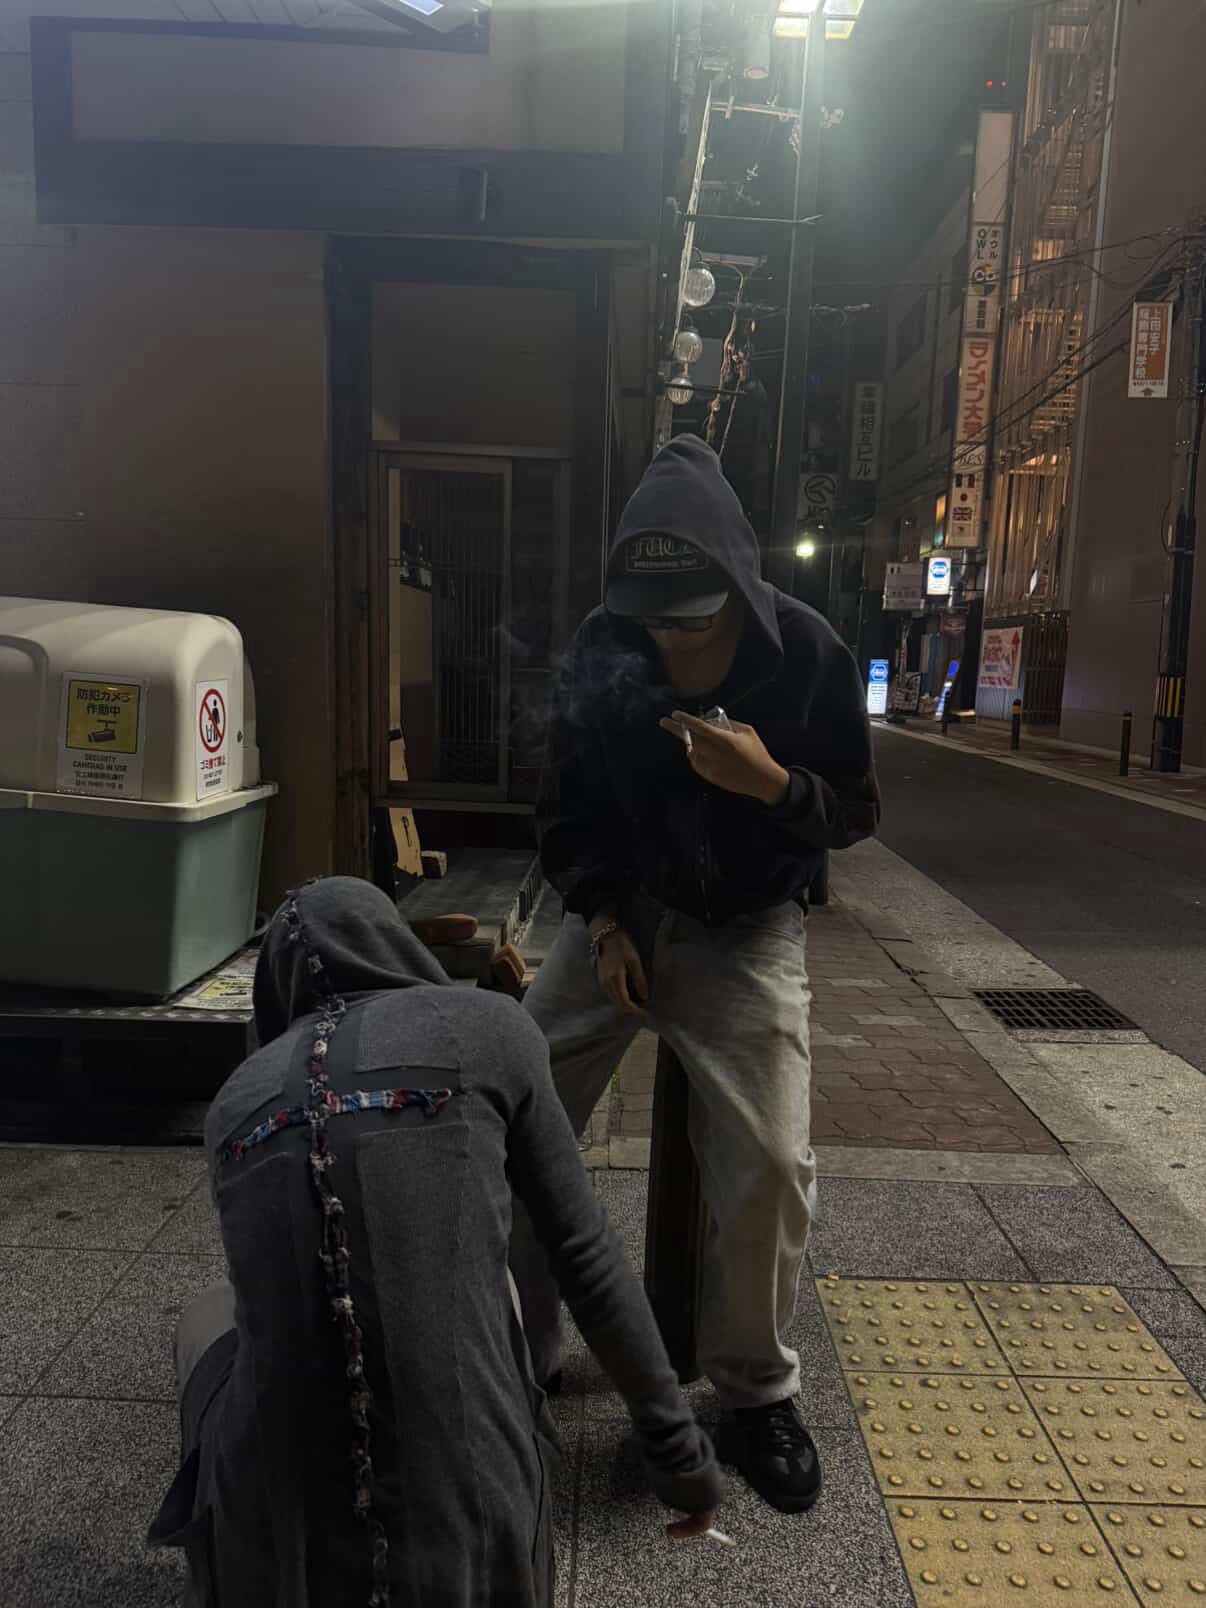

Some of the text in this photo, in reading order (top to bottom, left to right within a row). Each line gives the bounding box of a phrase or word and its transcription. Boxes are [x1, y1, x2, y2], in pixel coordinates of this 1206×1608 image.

[977, 229, 986, 260] OWL
[77, 687, 131, 703] 防犯カメラ
[87, 703, 121, 717] 作動中
[84, 752, 117, 763] SECURITY
